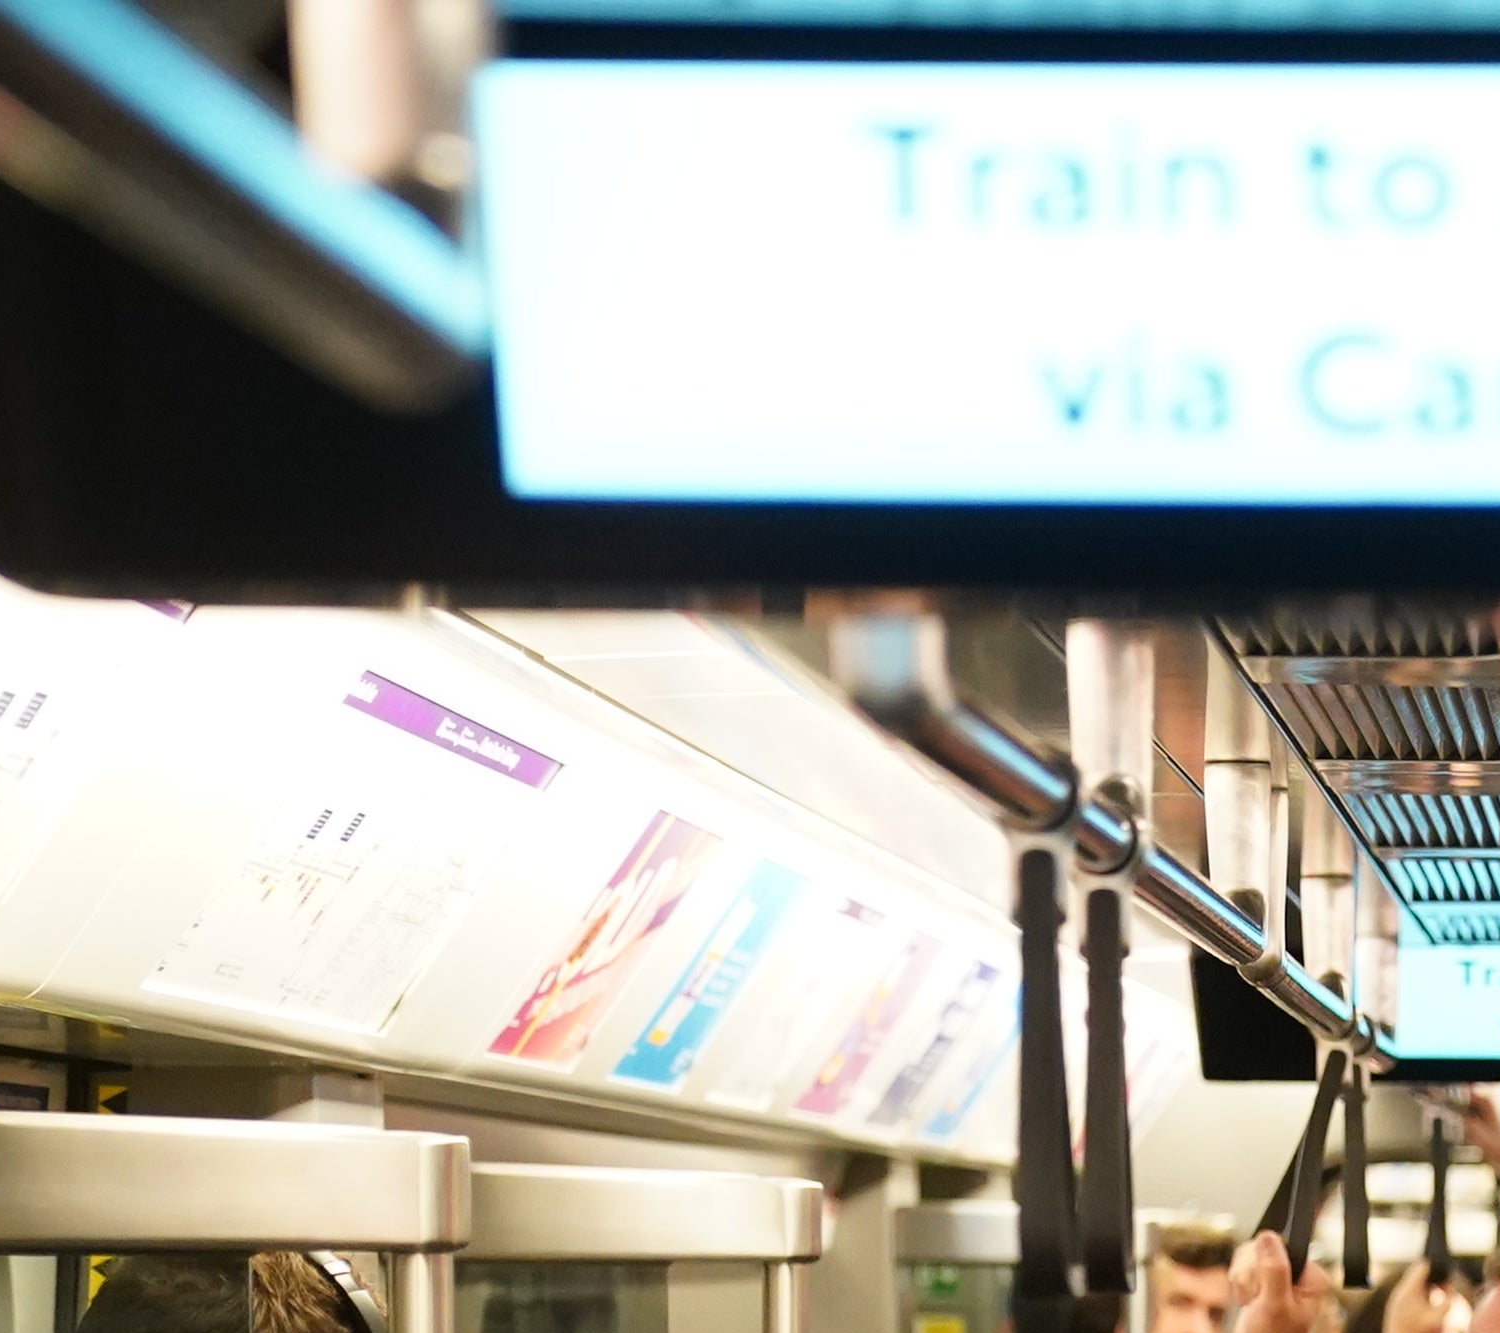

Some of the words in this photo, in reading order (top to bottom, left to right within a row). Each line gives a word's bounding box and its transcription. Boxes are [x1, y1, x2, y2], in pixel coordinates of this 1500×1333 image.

[866, 120, 1235, 228] Train
[1304, 138, 1452, 228] to
[1035, 328, 1232, 433] via
